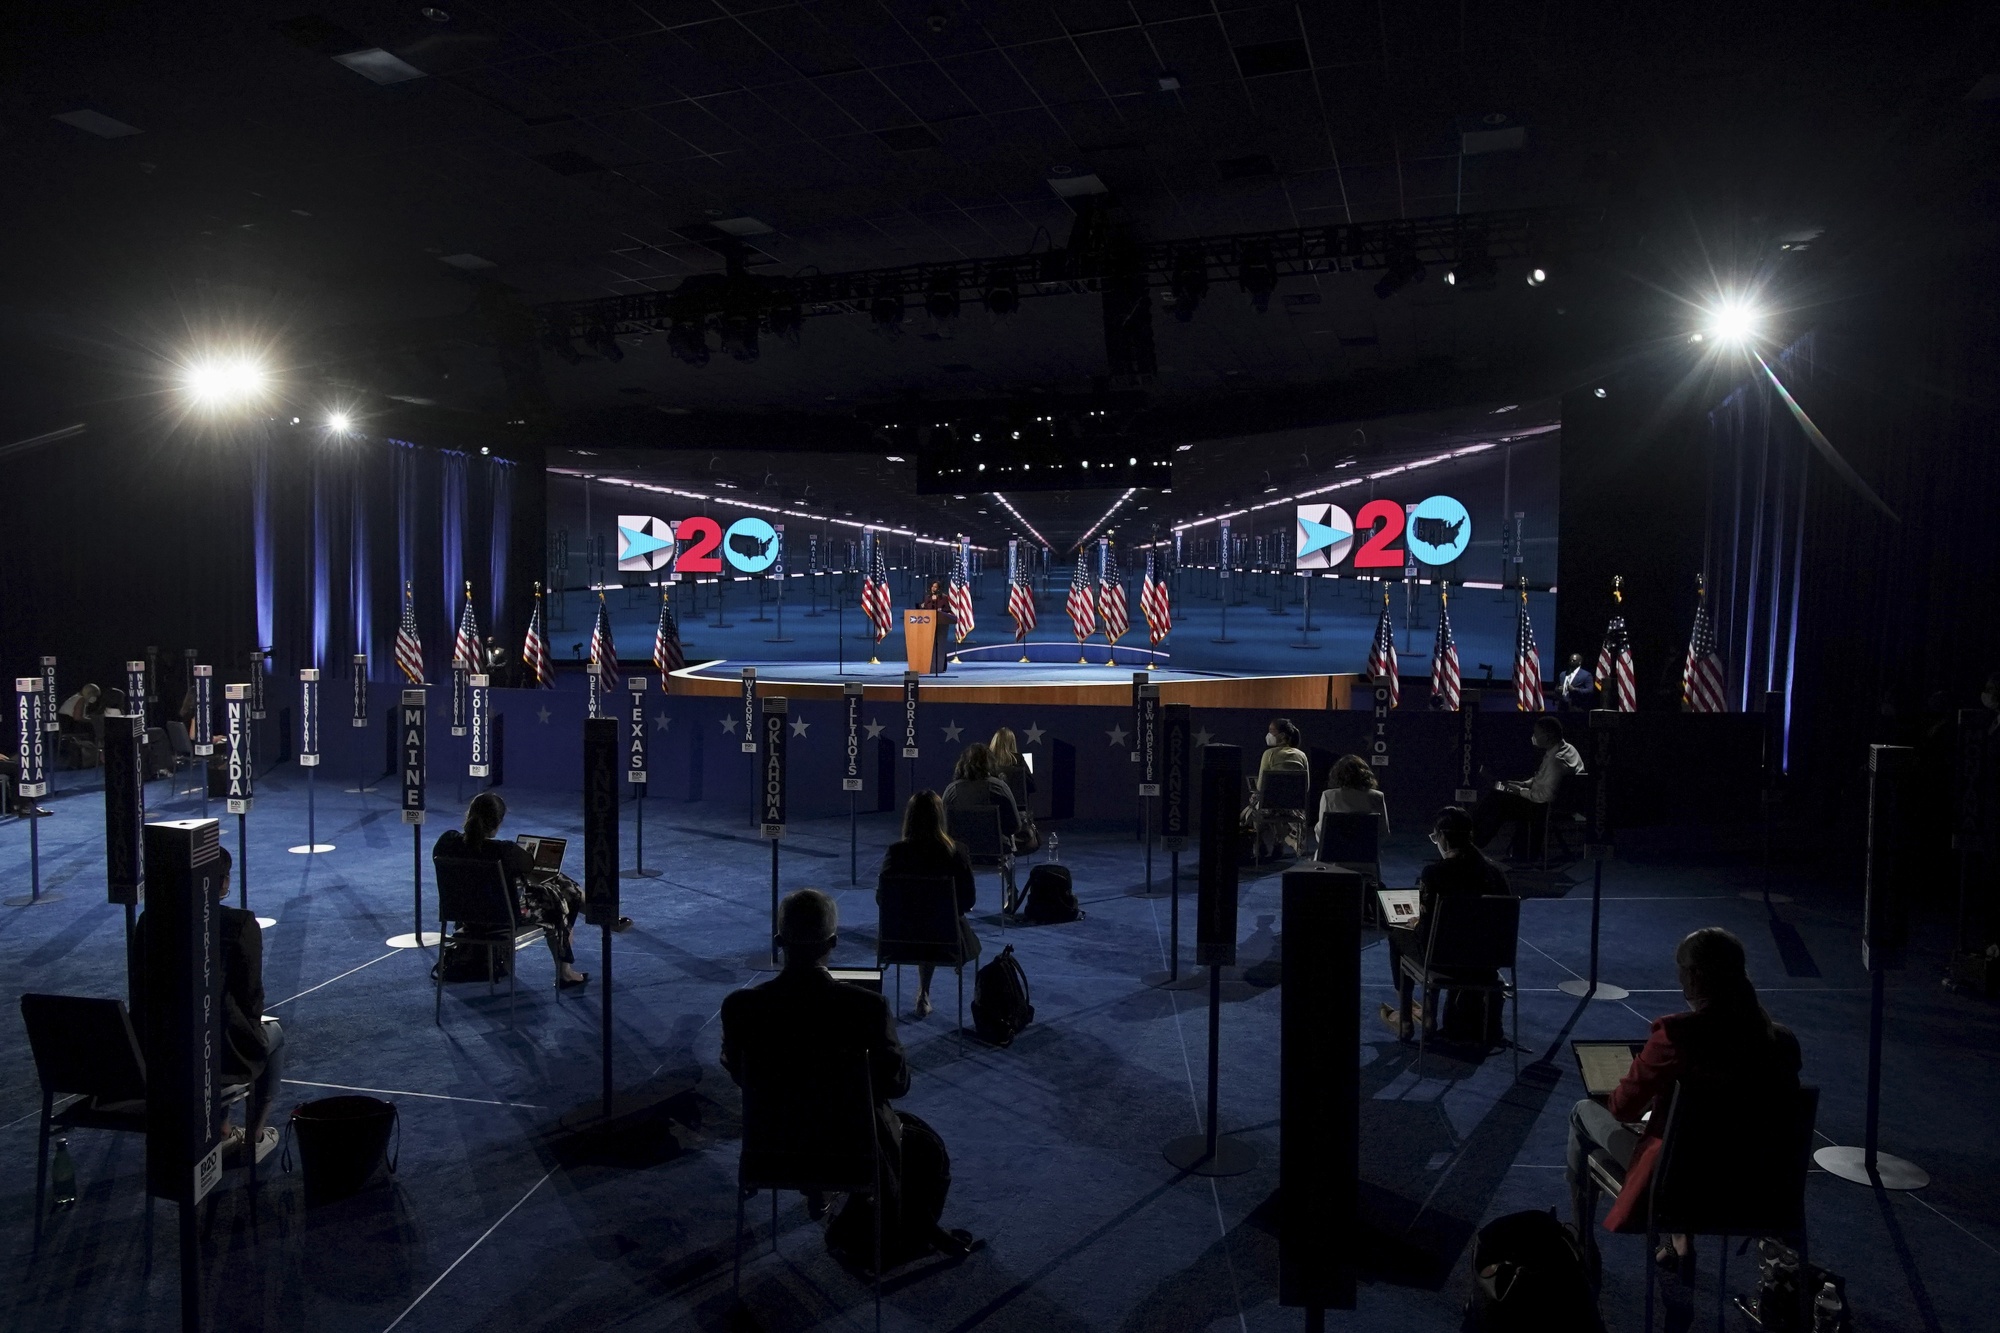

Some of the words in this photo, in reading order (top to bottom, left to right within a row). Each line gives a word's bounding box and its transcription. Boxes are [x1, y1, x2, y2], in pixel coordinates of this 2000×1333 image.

[810, 540, 818, 569] MAINE
[1220, 527, 1229, 571] ARIZONA
[47, 667, 57, 722] OREGON
[136, 673, 145, 697] NEW
[744, 679, 754, 741] WISCONSIN
[906, 682, 915, 746] FLORIDA
[1145, 700, 1155, 720] NEW
[1374, 688, 1388, 753] OHIO
[19, 695, 30, 781] ARIZONA
[33, 695, 43, 780] ARIZONA
[228, 702, 242, 796] NEVADA
[244, 702, 252, 796] NEVADA
[405, 709, 421, 806] MAINE
[472, 689, 481, 763] COLORADO
[631, 692, 643, 769] TEXAS
[847, 697, 858, 776] ILLINOIS
[766, 717, 781, 820] OKLAHOMA
[1168, 724, 1184, 832] ARKANSAS
[135, 742, 144, 878] LOUISIANA
[202, 876, 210, 988] DISTRICT
[203, 994, 211, 1024] OF
[204, 1030, 212, 1143] COLUMBIA
